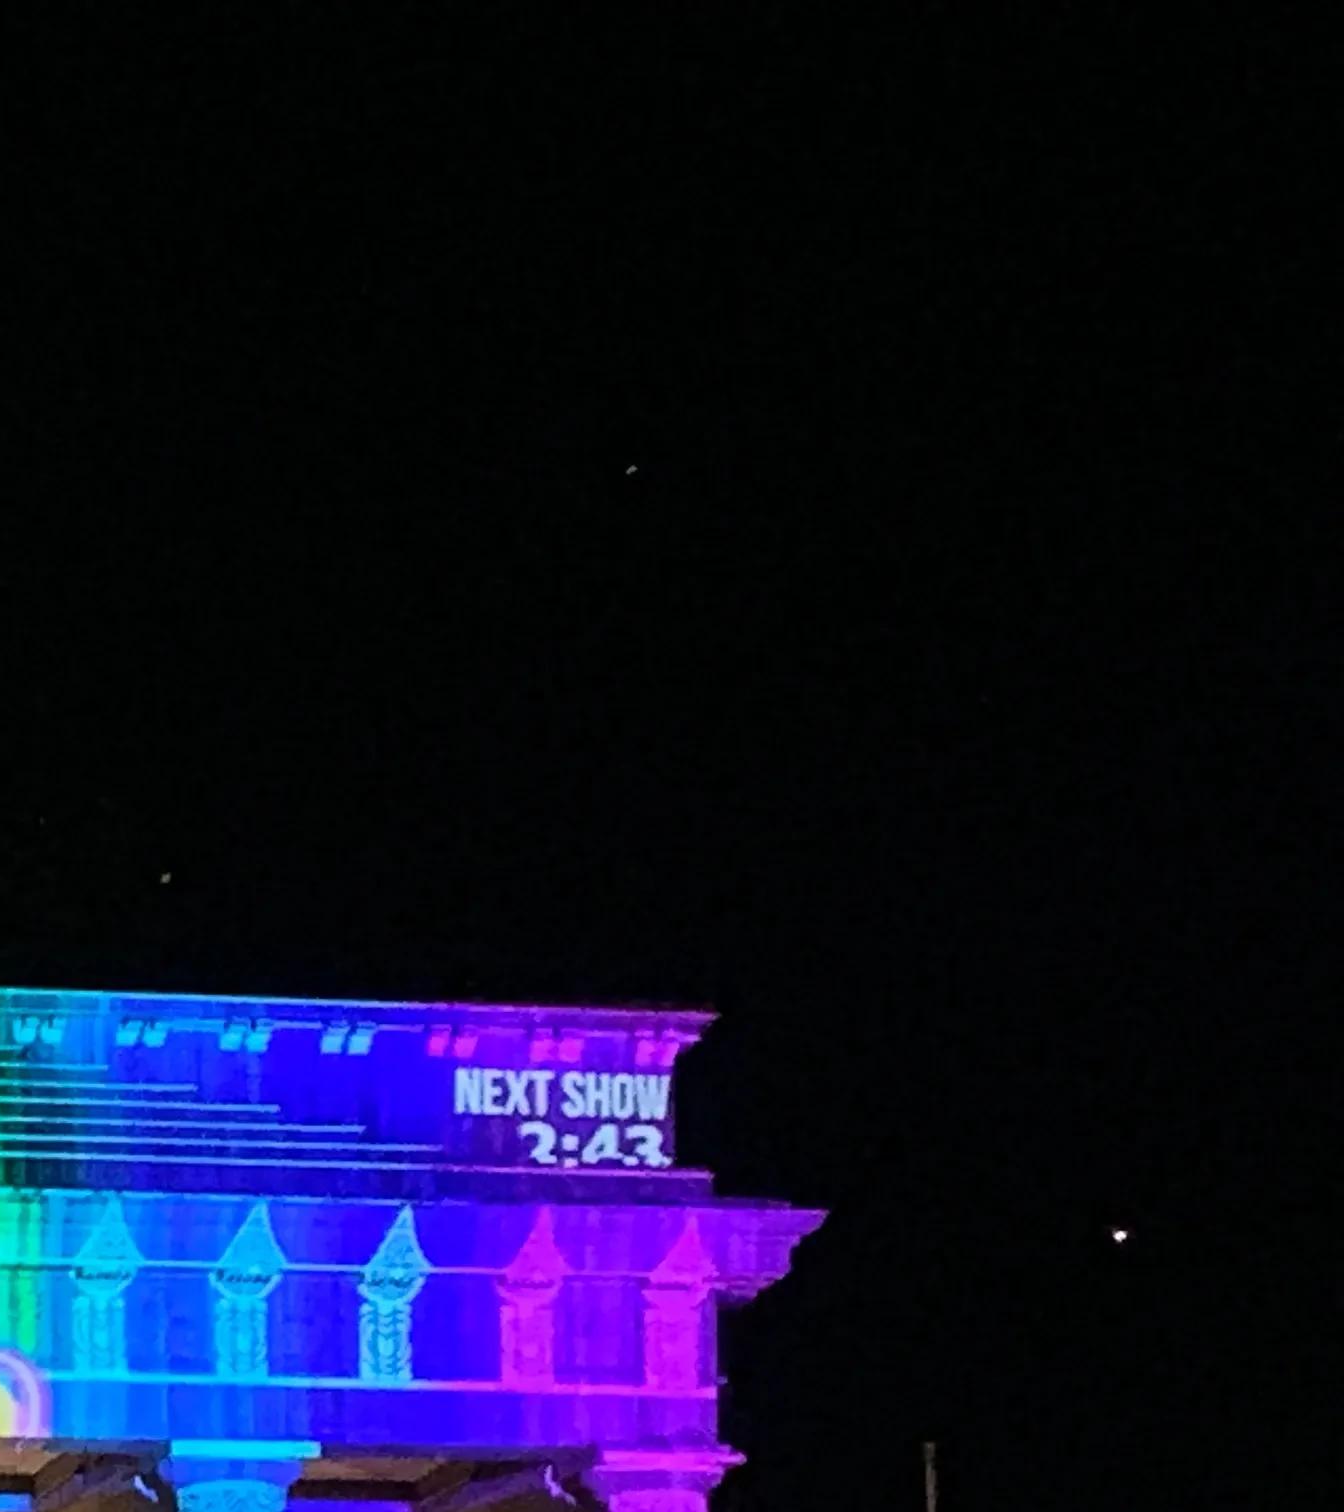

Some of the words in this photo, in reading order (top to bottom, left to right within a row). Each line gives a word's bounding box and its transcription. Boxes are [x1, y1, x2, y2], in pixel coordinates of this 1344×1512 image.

[453, 1067, 555, 1117] NEXT
[561, 1071, 671, 1120] SHOW
[517, 1120, 674, 1168] 2:43
